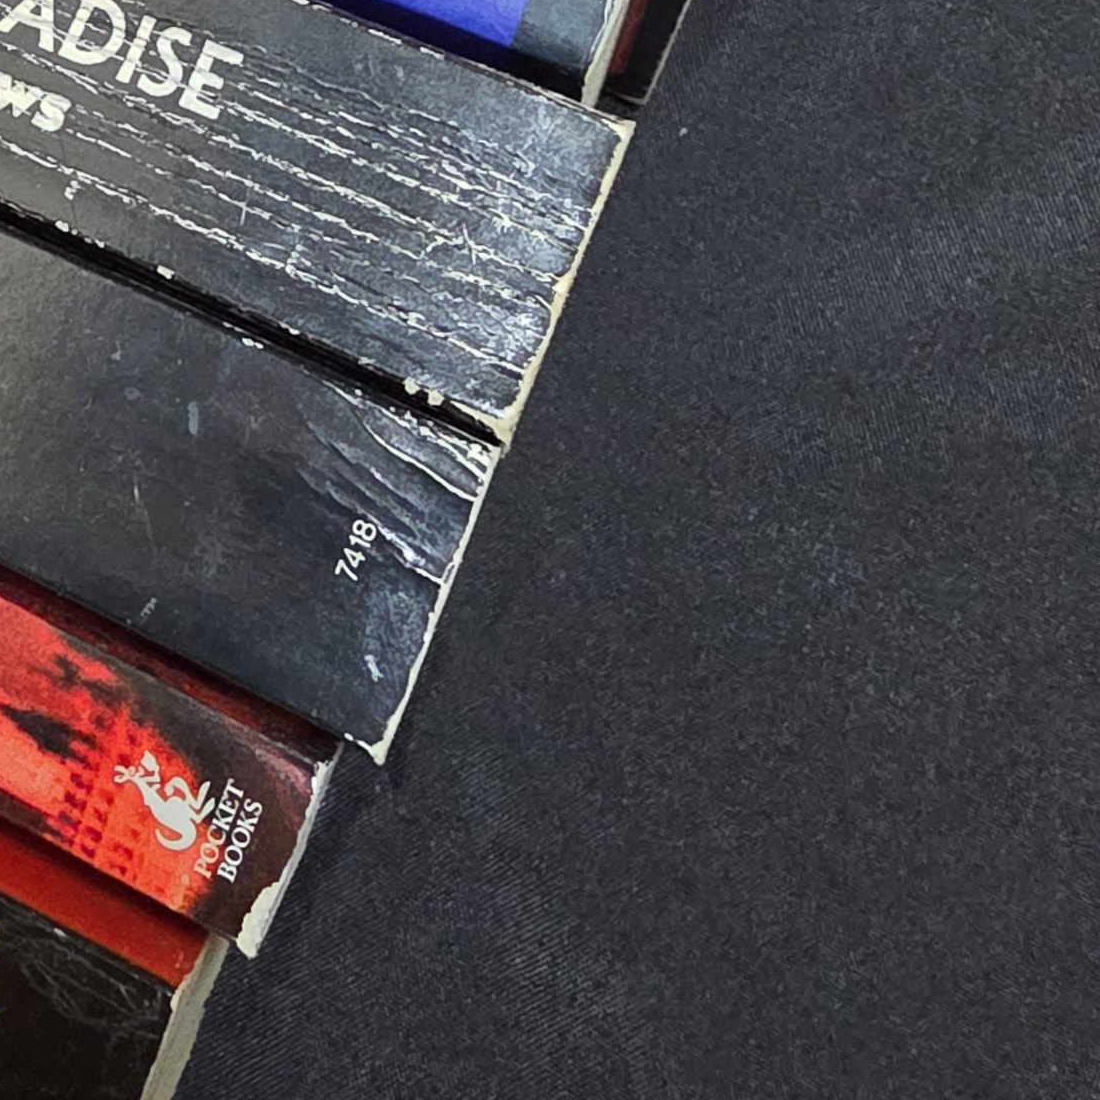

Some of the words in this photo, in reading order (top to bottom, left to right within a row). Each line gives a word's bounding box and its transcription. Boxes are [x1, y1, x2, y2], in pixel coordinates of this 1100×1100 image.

[335, 520, 377, 581] 7418
[193, 778, 244, 879] POCKET
[217, 798, 263, 883] BOOKS
